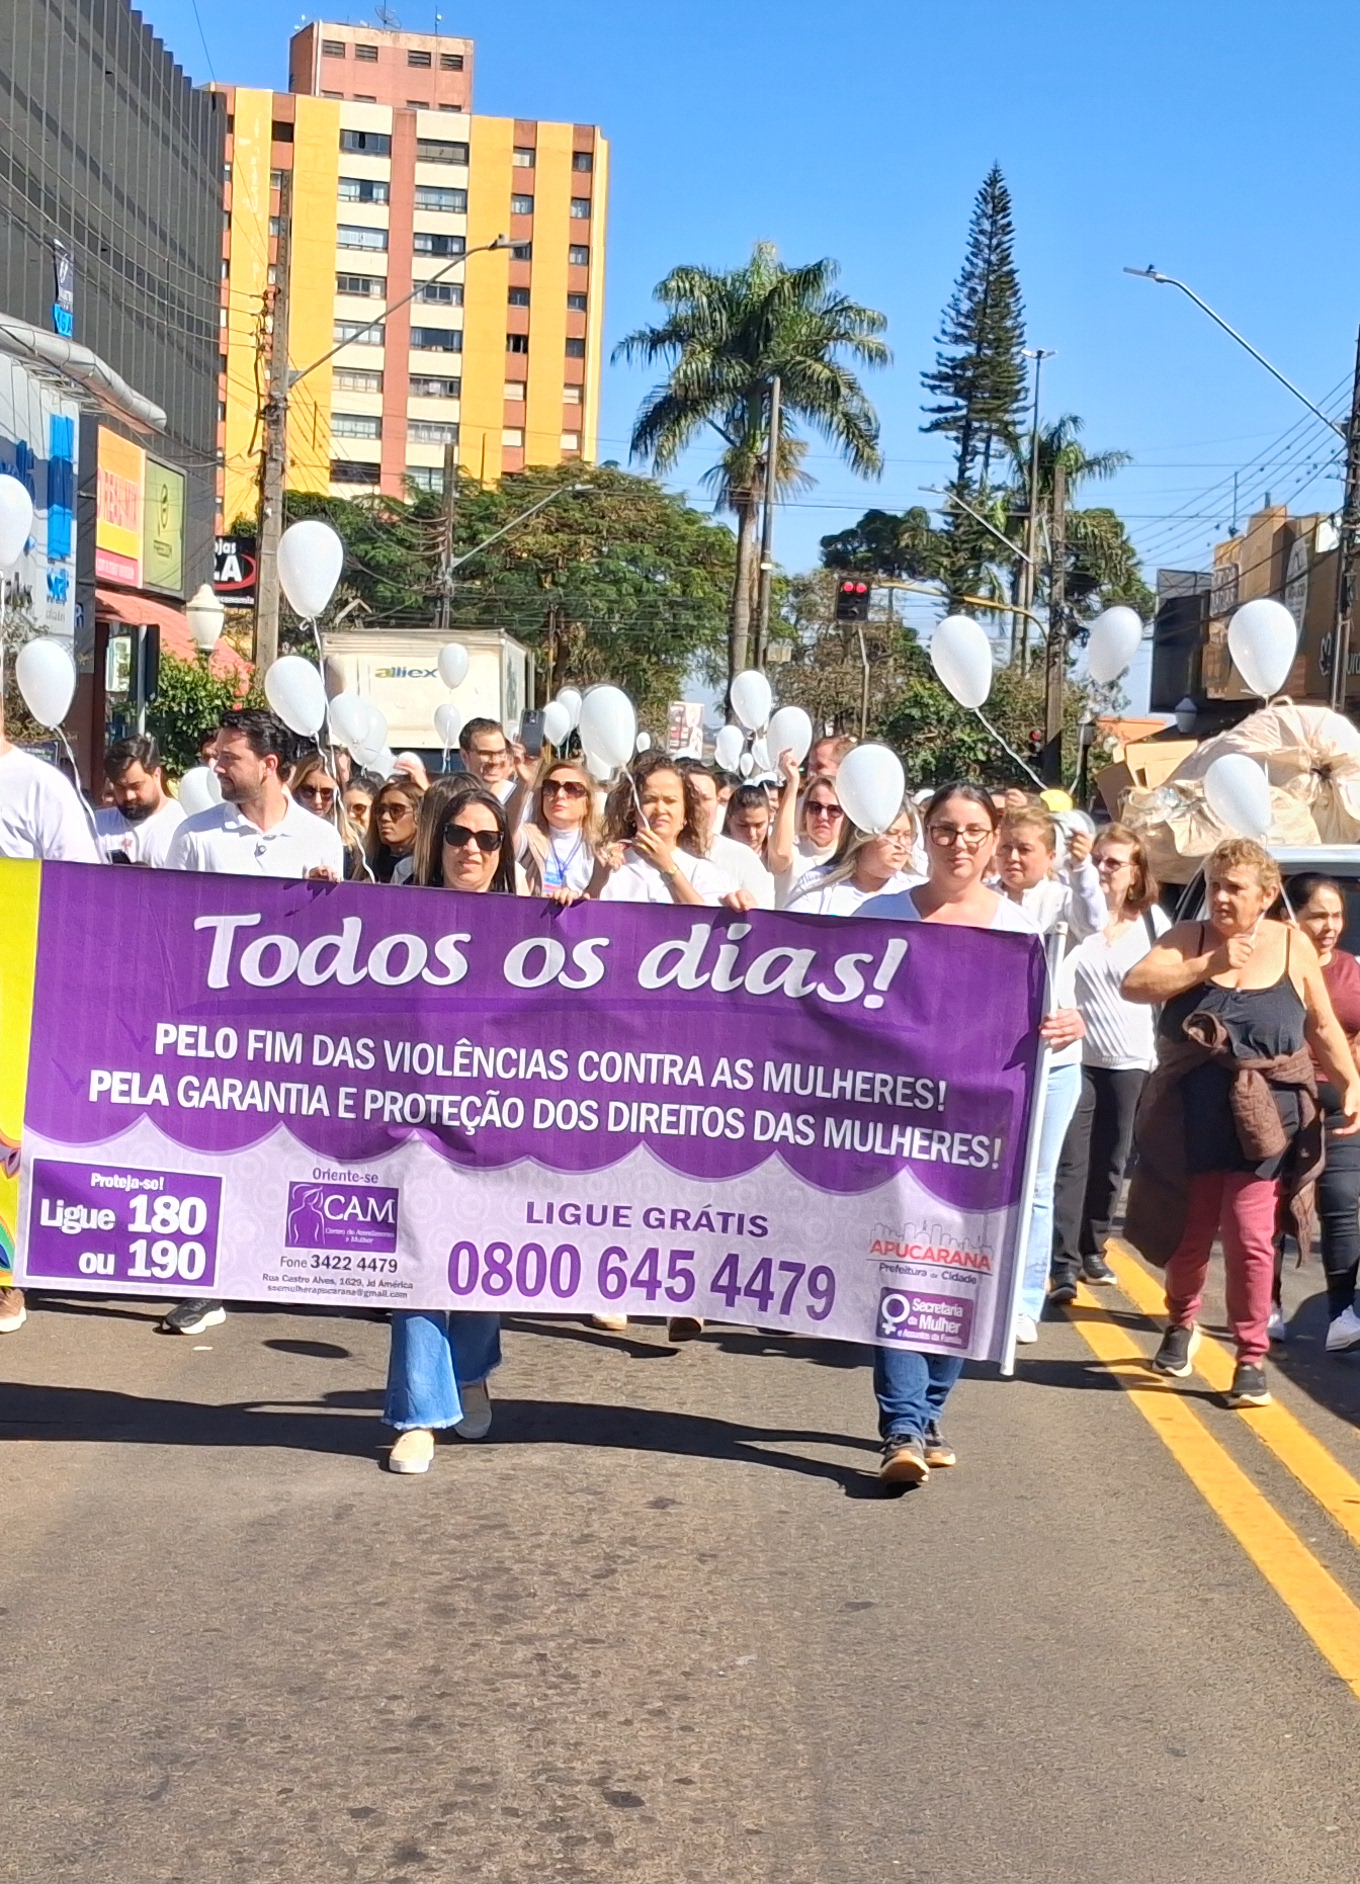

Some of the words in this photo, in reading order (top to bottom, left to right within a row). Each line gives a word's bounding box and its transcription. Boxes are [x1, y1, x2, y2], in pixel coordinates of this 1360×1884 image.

[375, 667, 439, 678] alliex
[194, 913, 471, 989] Todos
[503, 937, 610, 989] os
[638, 923, 908, 1009] dias!
[155, 1022, 238, 1060] PELO
[247, 1029, 304, 1064] FIM
[312, 1034, 375, 1070] DAS
[383, 1037, 569, 1081] VIOLÊNCIAS
[578, 1051, 705, 1087] CONTRA
[710, 1057, 754, 1091] AS
[762, 1060, 948, 1112] MULHERES!
[89, 1069, 170, 1107] PELA
[177, 1075, 330, 1117] GARANTIA
[338, 1086, 358, 1119] E
[364, 1088, 525, 1136] PROTEÇÃO
[533, 1098, 600, 1132] DOS
[607, 1102, 745, 1140] DIREITOS
[754, 1109, 816, 1147] DAS
[824, 1117, 1002, 1171] MULHERES!
[90, 1172, 165, 1192] Proteja-se!
[312, 1167, 379, 1184] Oriente-se
[39, 1198, 116, 1235] Ligue
[128, 1194, 208, 1236] 180
[323, 1194, 396, 1224] CAM
[526, 1201, 633, 1228] LIGUE
[642, 1204, 770, 1238] GRÁTIS
[78, 1252, 115, 1275] ou
[127, 1239, 207, 1280] 190
[280, 1256, 308, 1268] Fone
[310, 1254, 352, 1271] 3422
[357, 1257, 398, 1273] 4479
[869, 1239, 992, 1271] APUCARANA
[262, 1273, 279, 1281] Rua
[282, 1274, 310, 1283] Castro
[378, 1279, 414, 1289] América
[447, 1240, 582, 1298] 0800
[597, 1246, 695, 1303] 645
[710, 1252, 837, 1321] 4479
[879, 1262, 928, 1277] Prefeitura
[941, 1270, 978, 1285] Cidade
[912, 1298, 965, 1318] Secretaria
[919, 1314, 962, 1334] Mulher
